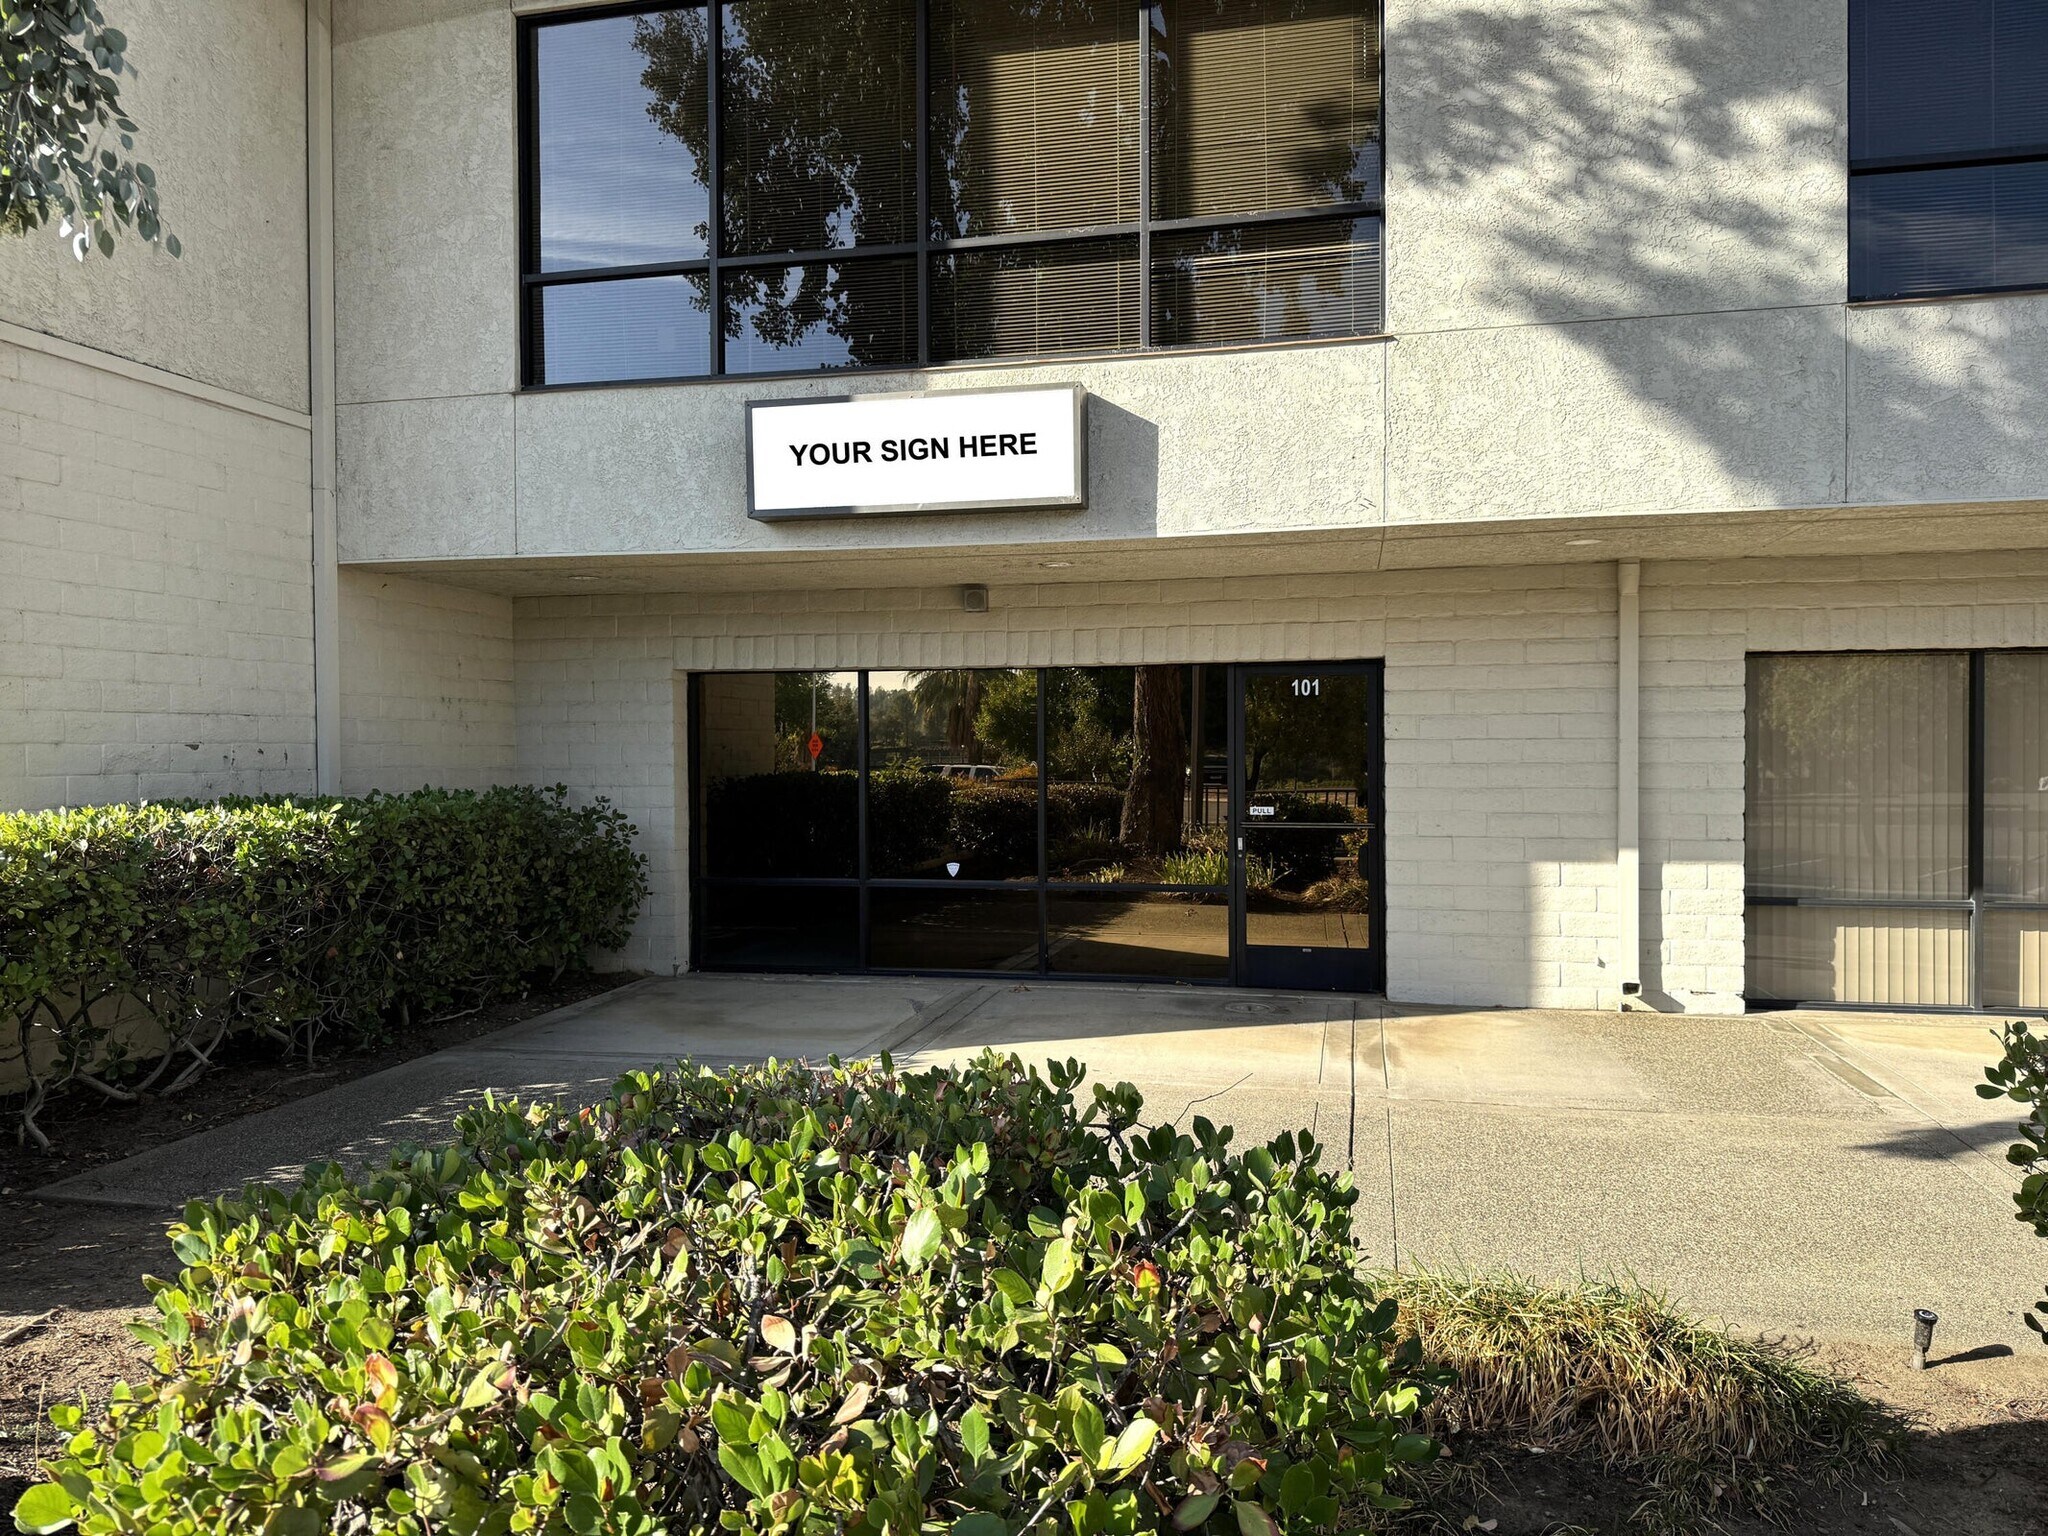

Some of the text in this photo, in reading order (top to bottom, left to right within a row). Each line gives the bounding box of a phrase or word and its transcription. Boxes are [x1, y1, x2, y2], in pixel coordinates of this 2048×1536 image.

[789, 432, 1038, 466] YOUR SIGN HERE
[1291, 679, 1319, 696] 101
